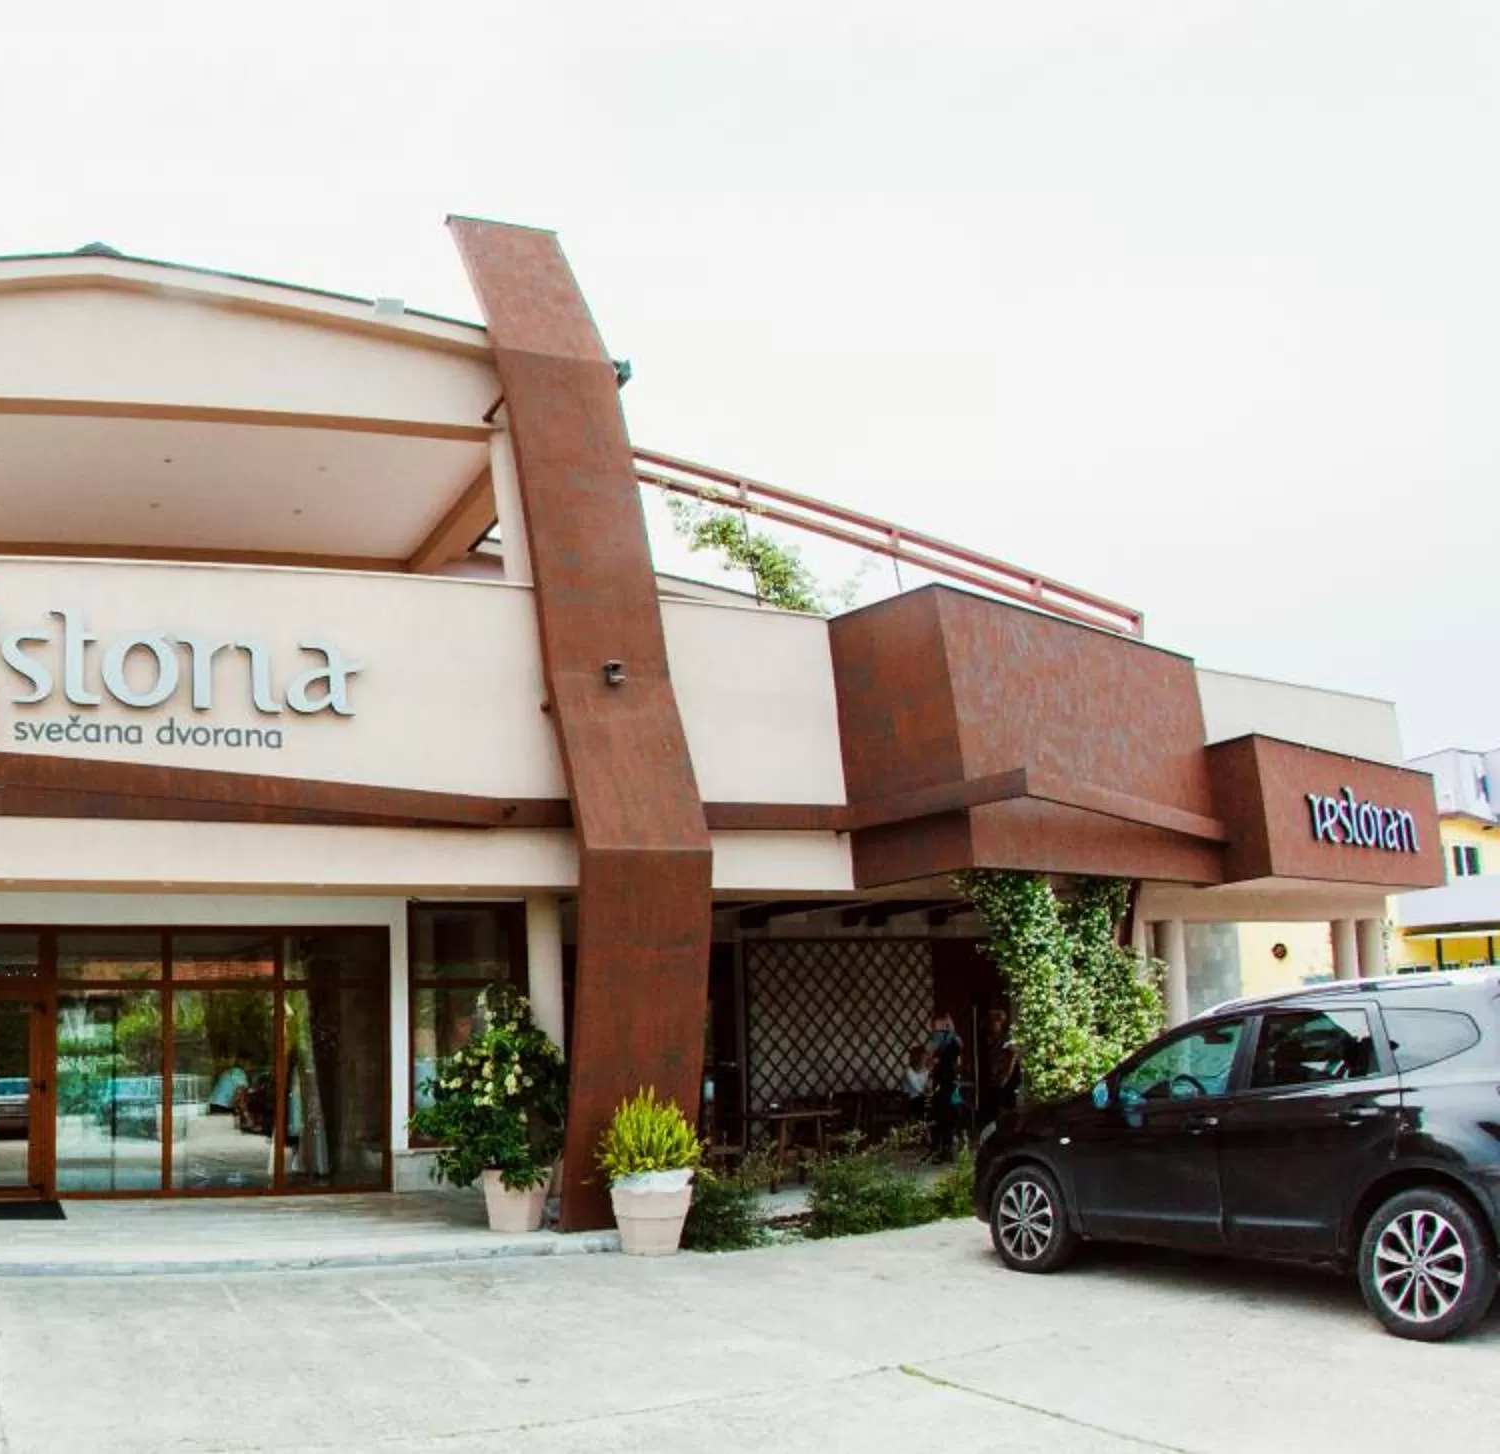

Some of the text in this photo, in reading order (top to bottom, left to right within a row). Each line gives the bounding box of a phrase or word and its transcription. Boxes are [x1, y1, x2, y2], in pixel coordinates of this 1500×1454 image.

[13, 714, 284, 750] svečana dvorana
[1304, 785, 1420, 853] restoran
